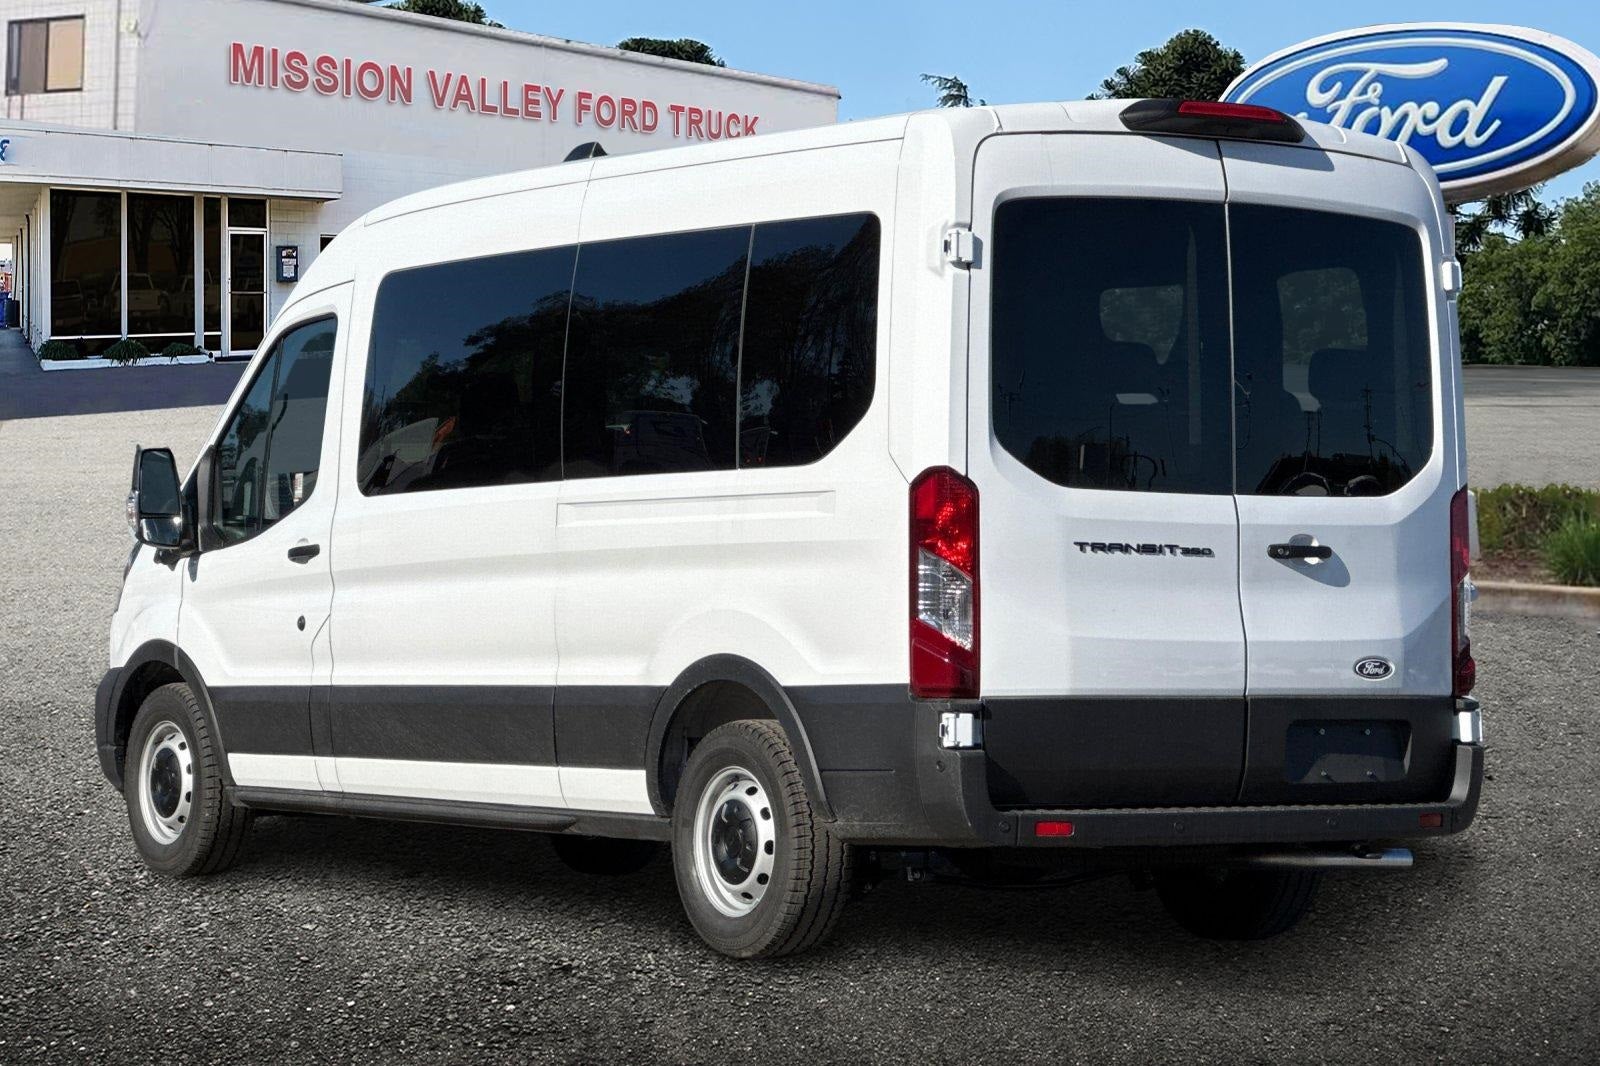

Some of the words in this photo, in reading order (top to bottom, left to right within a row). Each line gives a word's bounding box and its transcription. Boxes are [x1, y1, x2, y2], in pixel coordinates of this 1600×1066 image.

[230, 41, 412, 104] MISSION
[427, 68, 565, 122] VALLEY
[576, 90, 659, 133] FORD
[668, 104, 760, 140] TRUCK
[1300, 57, 1509, 148] Ford
[1073, 541, 1179, 556] TRANSIT
[1362, 660, 1386, 675] Ford
